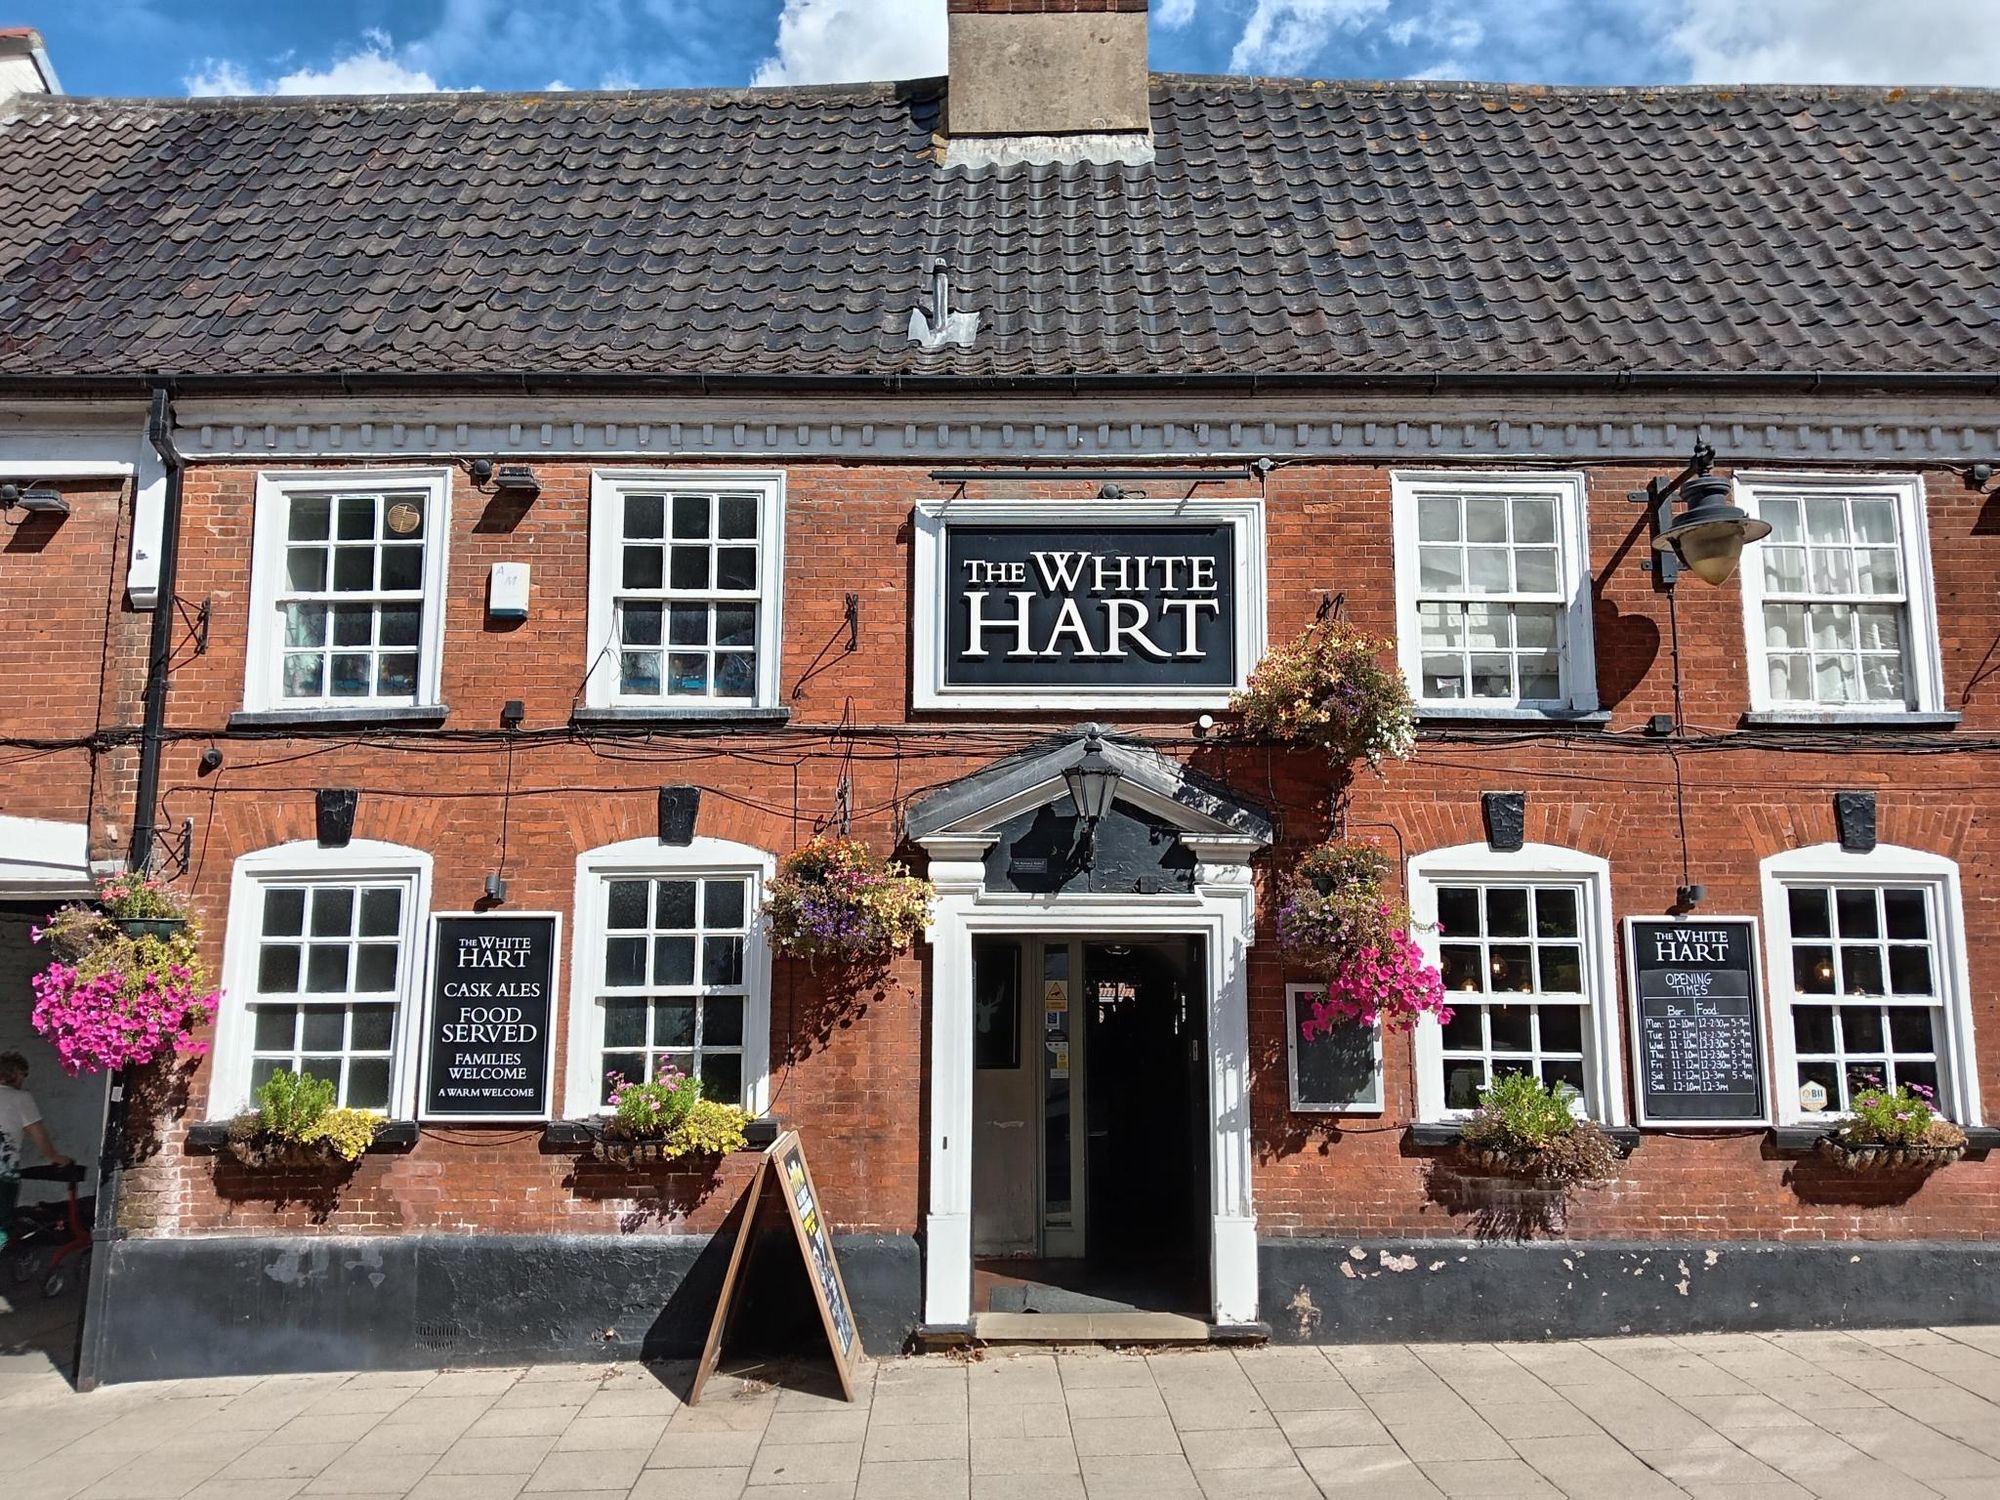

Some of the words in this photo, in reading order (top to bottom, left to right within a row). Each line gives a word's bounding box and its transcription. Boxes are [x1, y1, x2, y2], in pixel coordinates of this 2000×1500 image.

[963, 560, 1026, 583] THE
[1030, 551, 1218, 592] WHITE
[961, 591, 1220, 657] HART
[459, 938, 477, 947] THE
[478, 936, 530, 949] WHITE
[1655, 932, 1673, 940] THE
[1674, 930, 1728, 942] WHITE
[1656, 942, 1729, 961] HART
[457, 949, 530, 968] HART
[1666, 973, 1713, 985] OPENING
[444, 983, 492, 997] CASK
[496, 983, 540, 997] ALES
[1672, 985, 1708, 996] TIMES
[459, 1007, 522, 1024] FOOD
[441, 1024, 537, 1043] SERVED
[455, 1053, 521, 1065] FAMILIES
[449, 1067, 526, 1080] WELCOME
[438, 1088, 445, 1096] A
[446, 1088, 480, 1097] WARM
[482, 1088, 534, 1097] WELCOME
